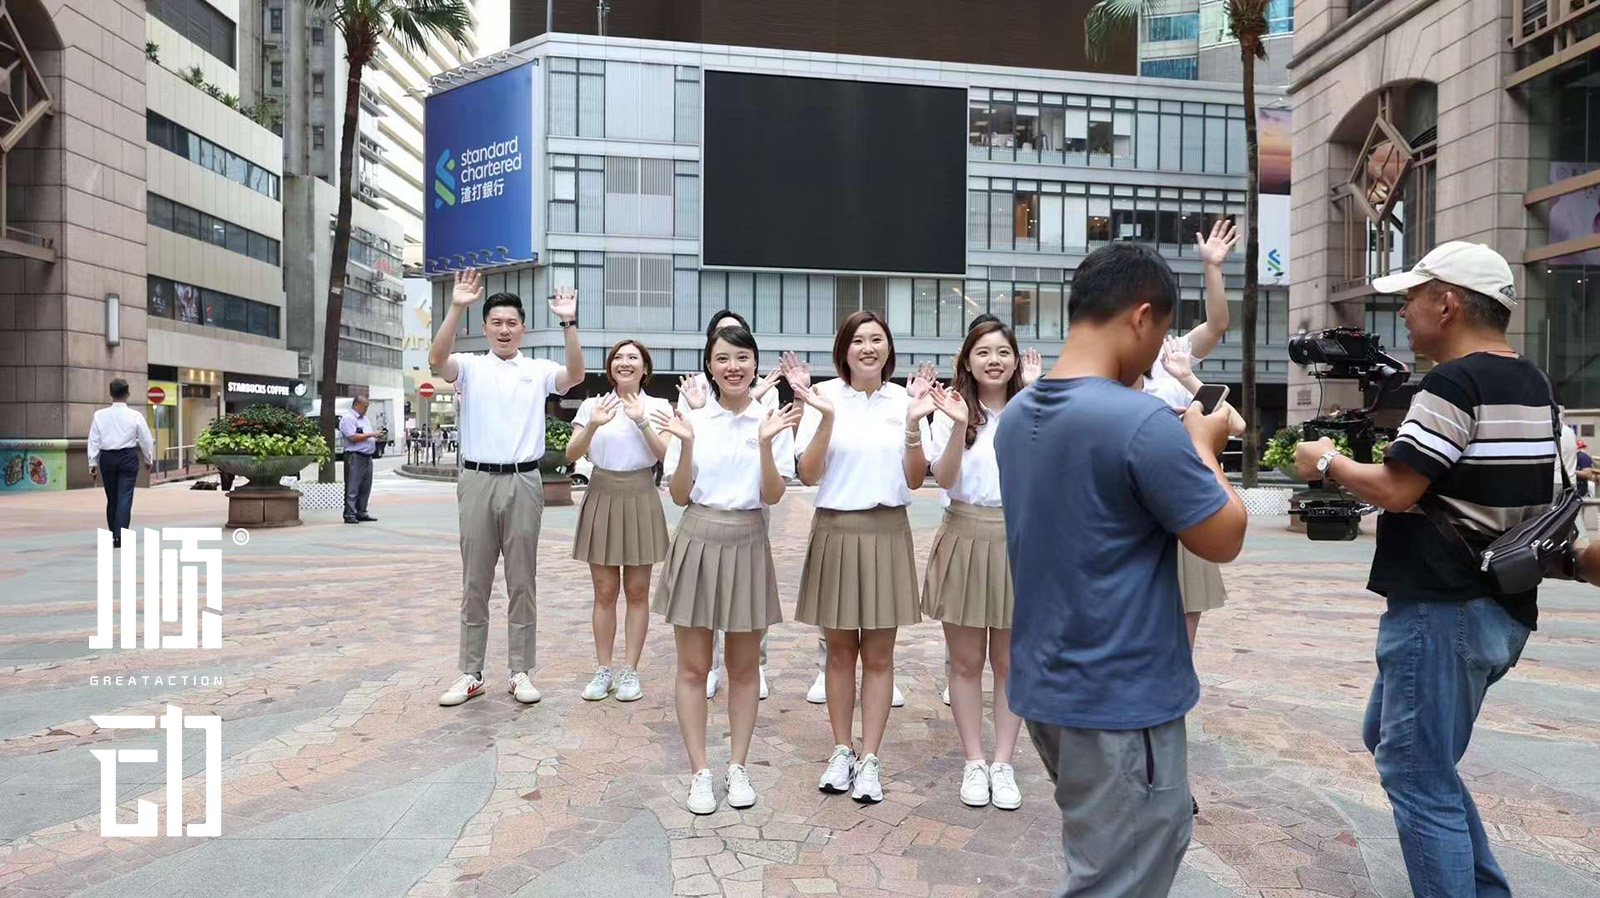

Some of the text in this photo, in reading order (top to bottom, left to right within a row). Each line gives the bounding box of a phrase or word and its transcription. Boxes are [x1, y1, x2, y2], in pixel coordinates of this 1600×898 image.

[461, 135, 518, 167] standard
[461, 152, 522, 183] chartered
[461, 178, 504, 204] 渣打銀行
[227, 381, 290, 396] STARBUCKS COFFEE
